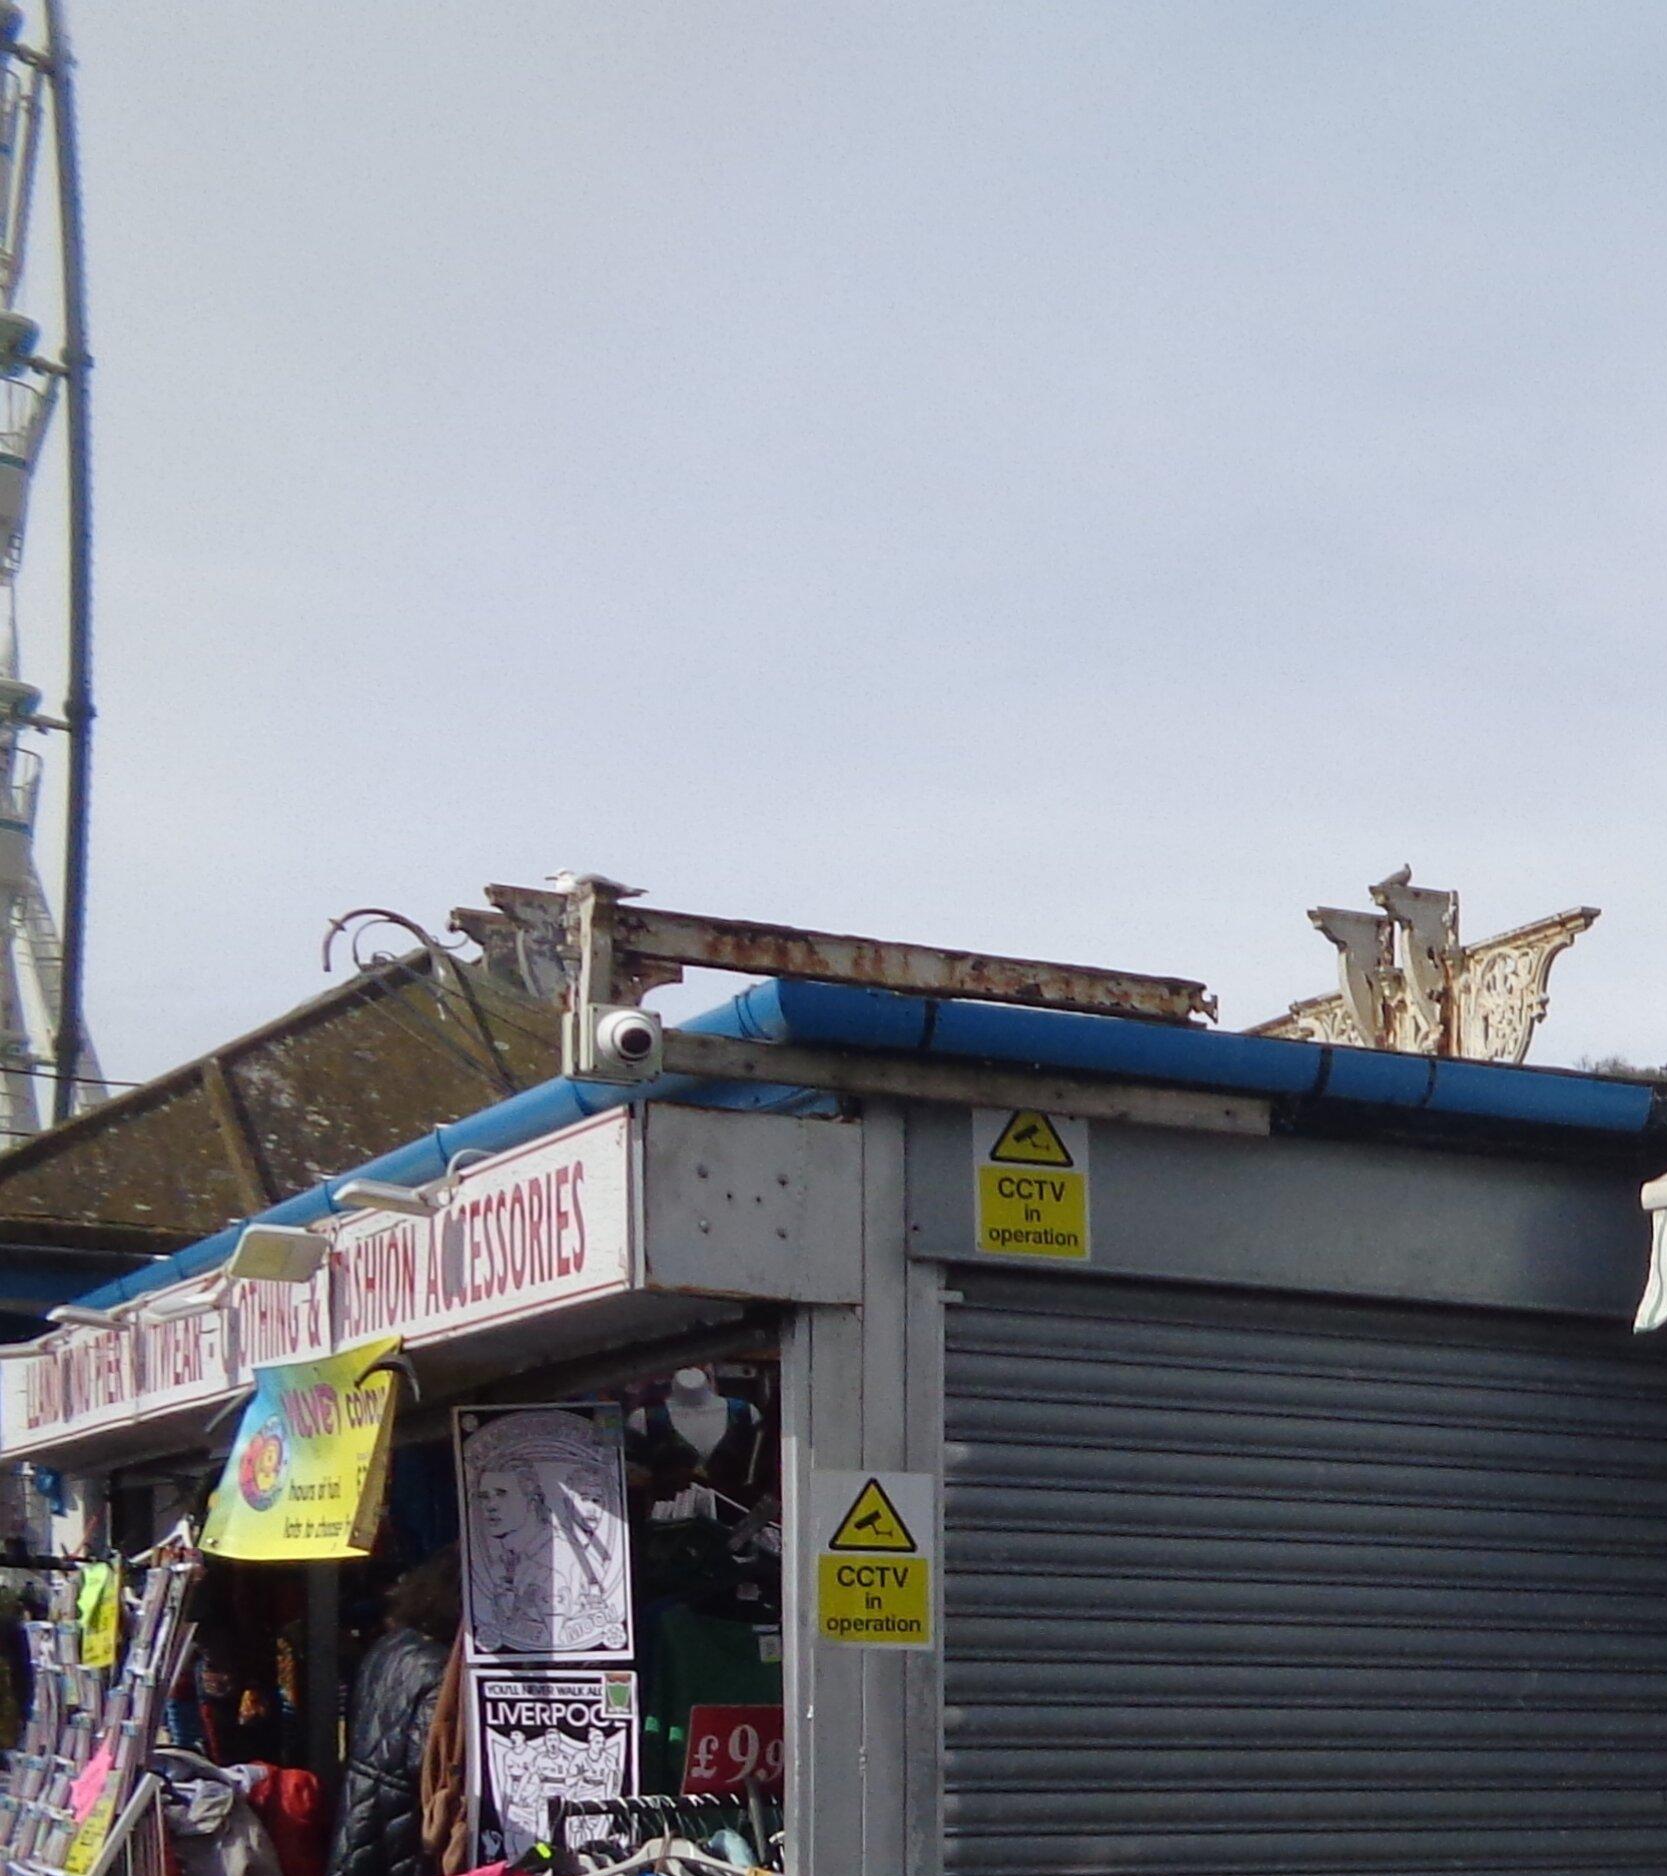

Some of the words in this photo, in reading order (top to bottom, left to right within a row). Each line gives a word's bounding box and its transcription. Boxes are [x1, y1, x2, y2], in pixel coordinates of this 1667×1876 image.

[997, 1176, 1066, 1201] CCTV
[1023, 1203, 1042, 1224] in
[987, 1226, 1080, 1248] operation
[220, 1280, 298, 1375] COTHING
[425, 1160, 587, 1318] ACCESSORIES
[836, 1565, 909, 1589] CCTV
[864, 1591, 882, 1611] in
[825, 1614, 922, 1635] operation
[486, 1701, 627, 1728] LIVERPOO
